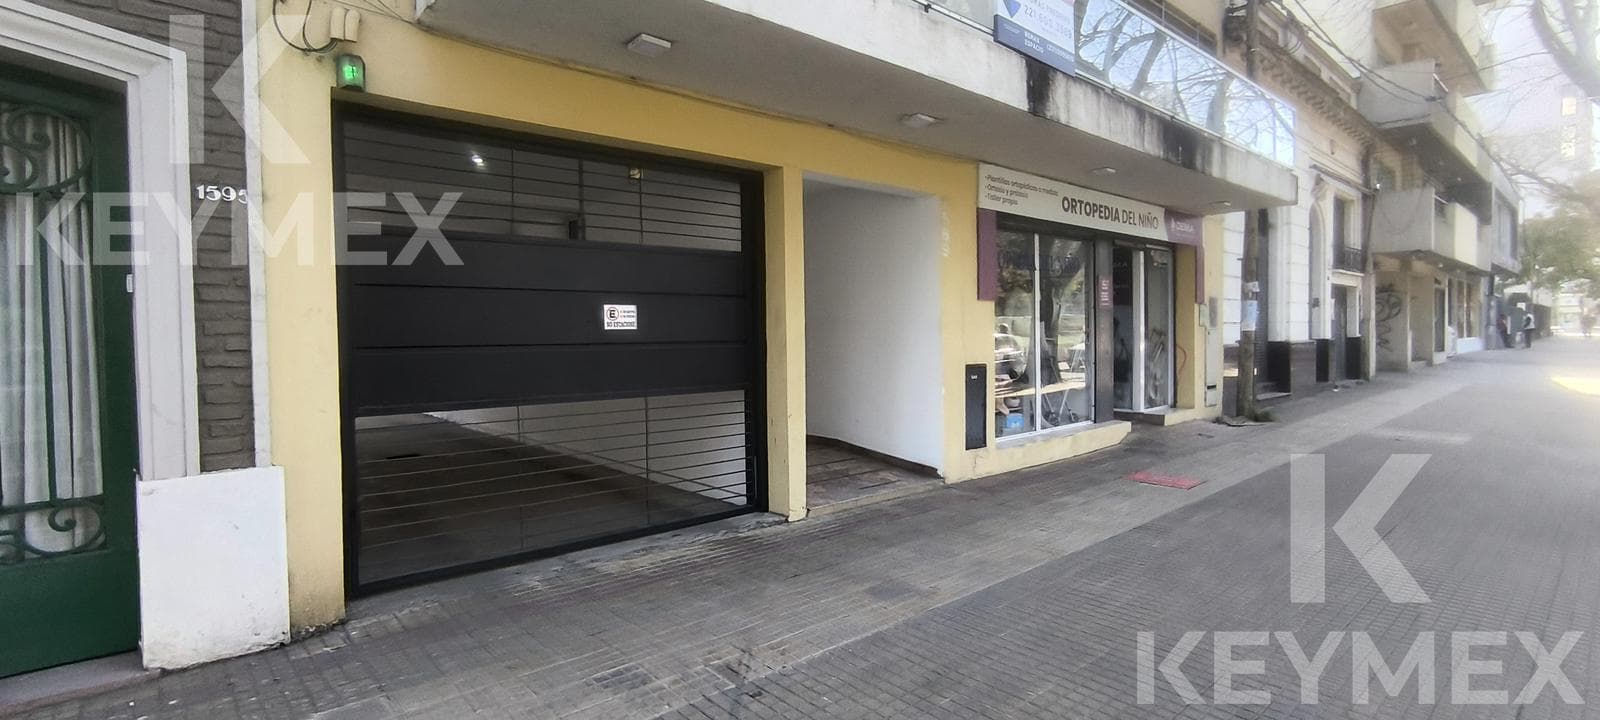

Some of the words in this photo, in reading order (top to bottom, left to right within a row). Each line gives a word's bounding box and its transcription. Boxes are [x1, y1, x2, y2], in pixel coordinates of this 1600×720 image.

[196, 184, 248, 204] 1595
[1061, 195, 1120, 223] ORTOPEDIA
[1121, 209, 1137, 226] DEL
[1138, 211, 1159, 230] NIÑO
[609, 309, 616, 318] E
